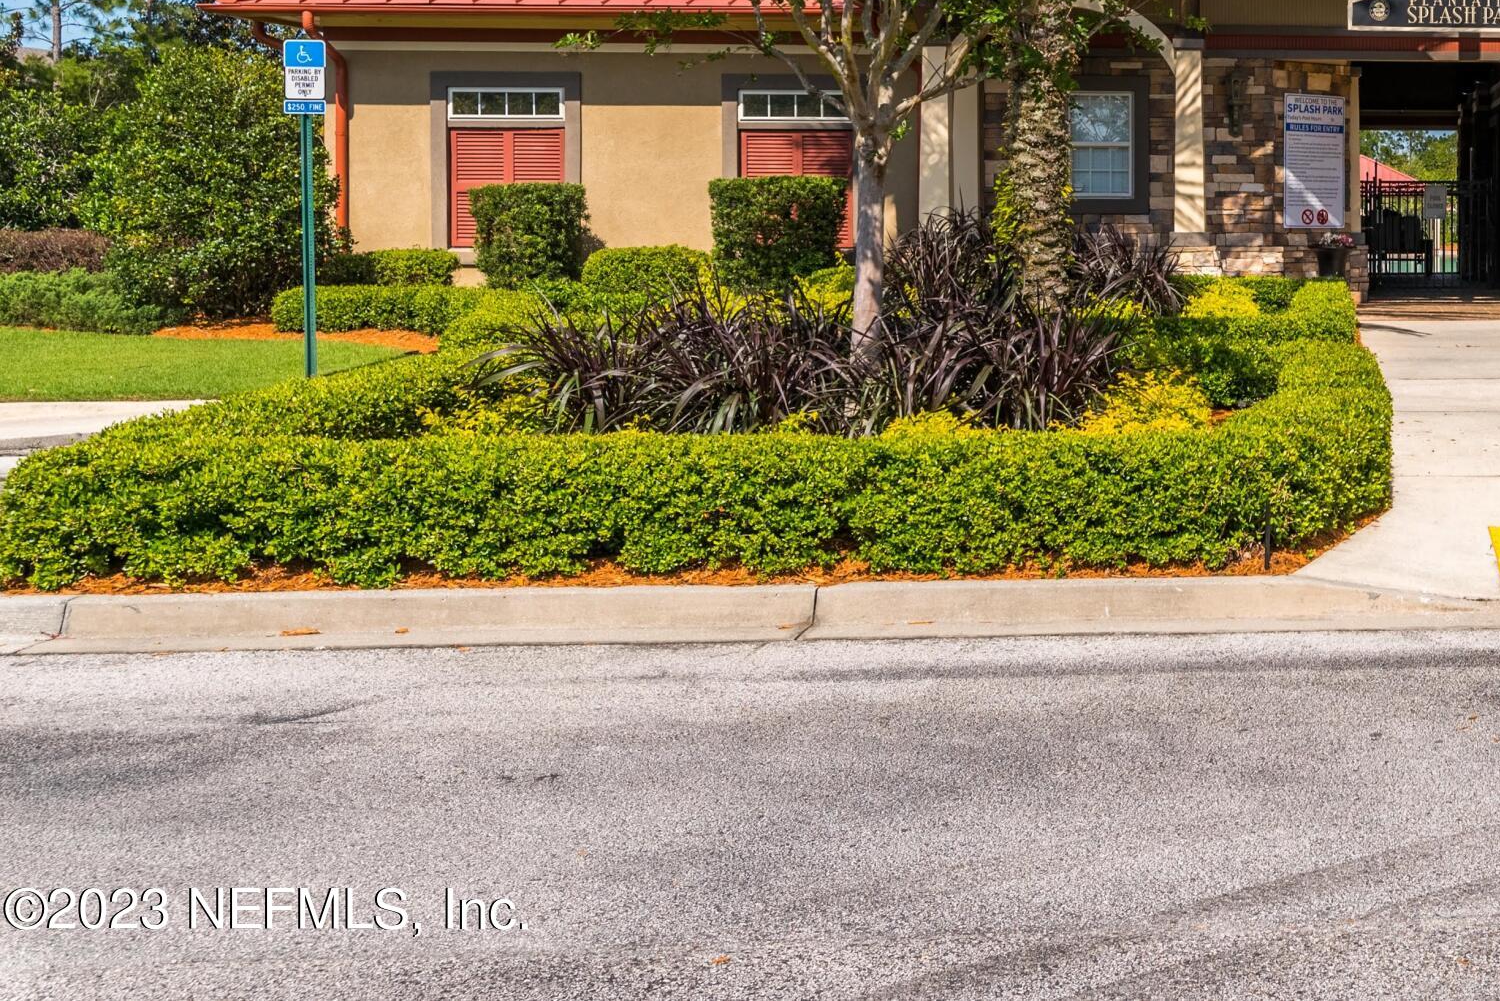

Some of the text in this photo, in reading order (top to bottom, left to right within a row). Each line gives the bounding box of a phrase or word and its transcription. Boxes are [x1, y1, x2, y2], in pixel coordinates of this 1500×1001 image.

[1407, 5, 1476, 24] SPLASH
[287, 103, 323, 111] $250 FINE
[1287, 103, 1343, 116] SPLASH PARK
[1290, 124, 1309, 132] RULES
